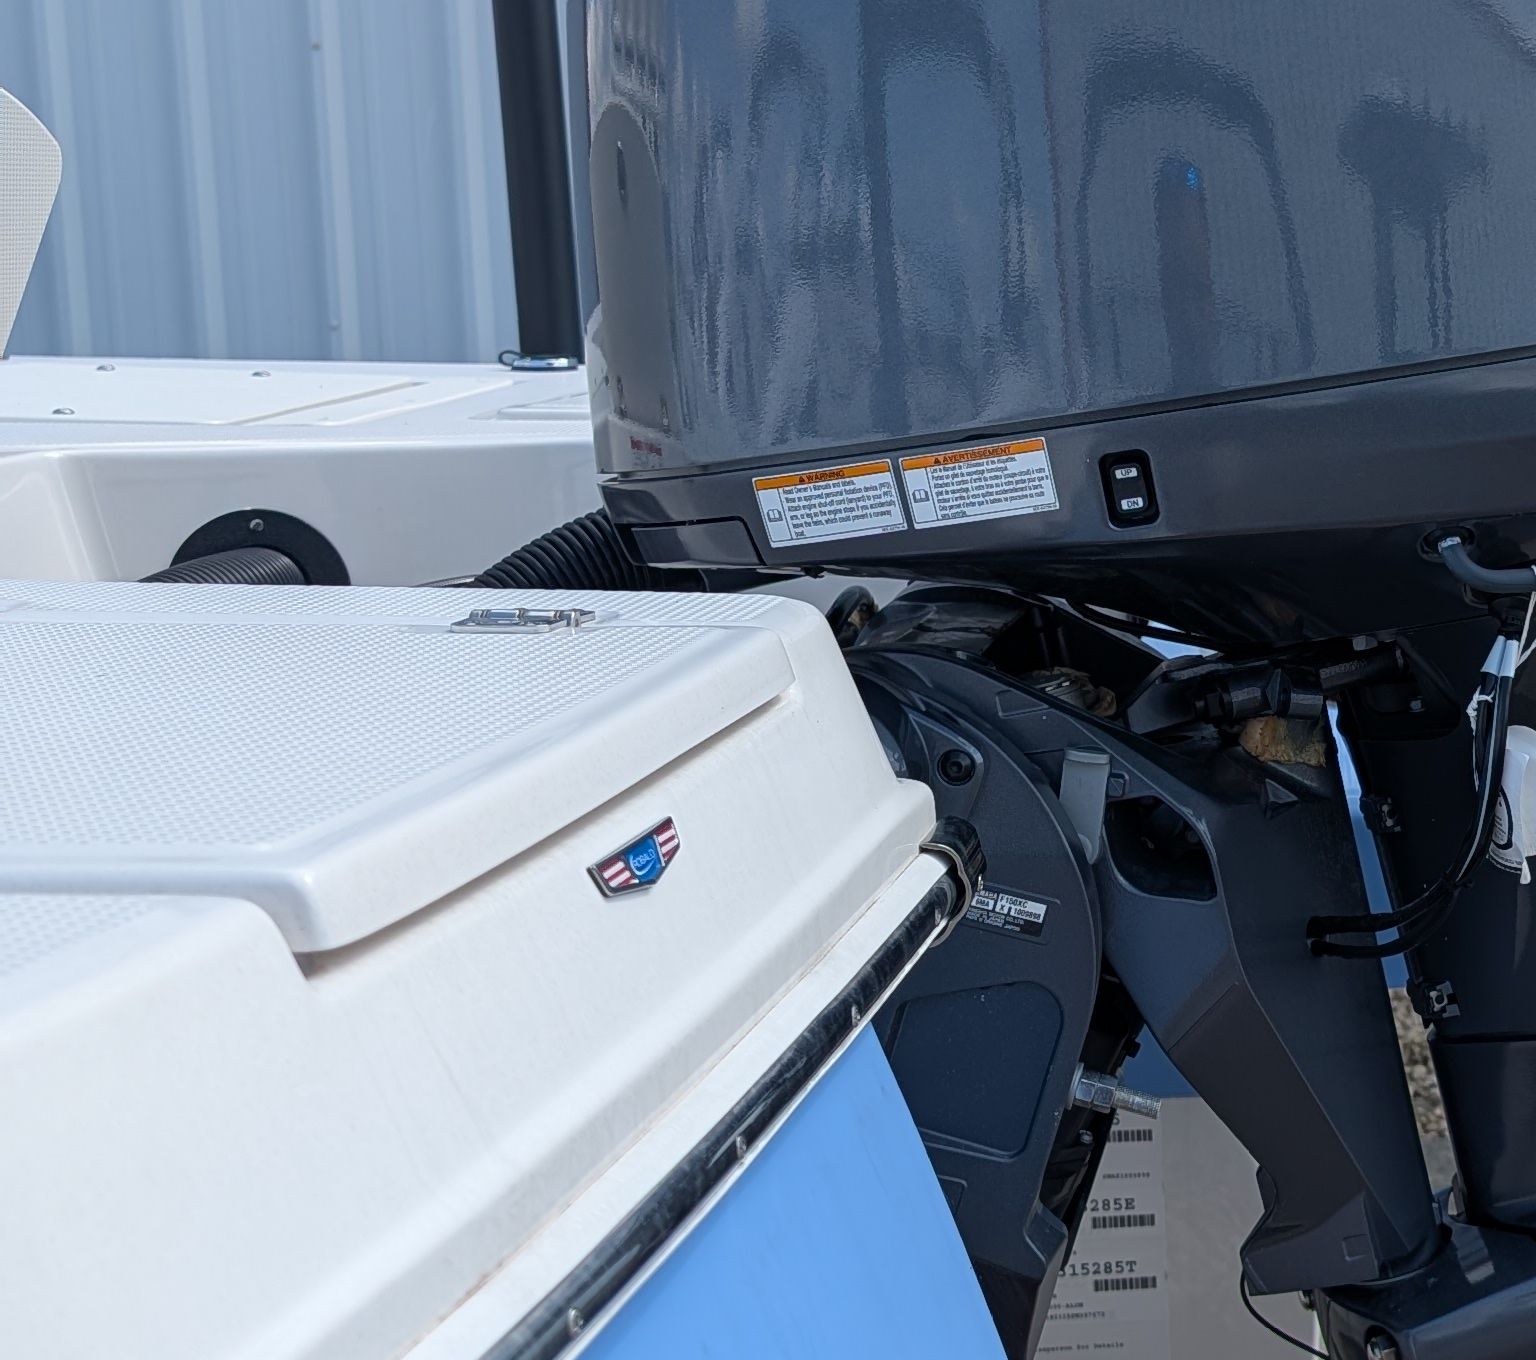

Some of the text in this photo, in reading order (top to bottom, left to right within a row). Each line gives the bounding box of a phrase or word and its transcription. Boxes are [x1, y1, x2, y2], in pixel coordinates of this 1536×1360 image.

[942, 446, 1011, 463] AVERTISSEMENT
[806, 470, 845, 481] WARNING
[1084, 1197, 1136, 1212] 285E
